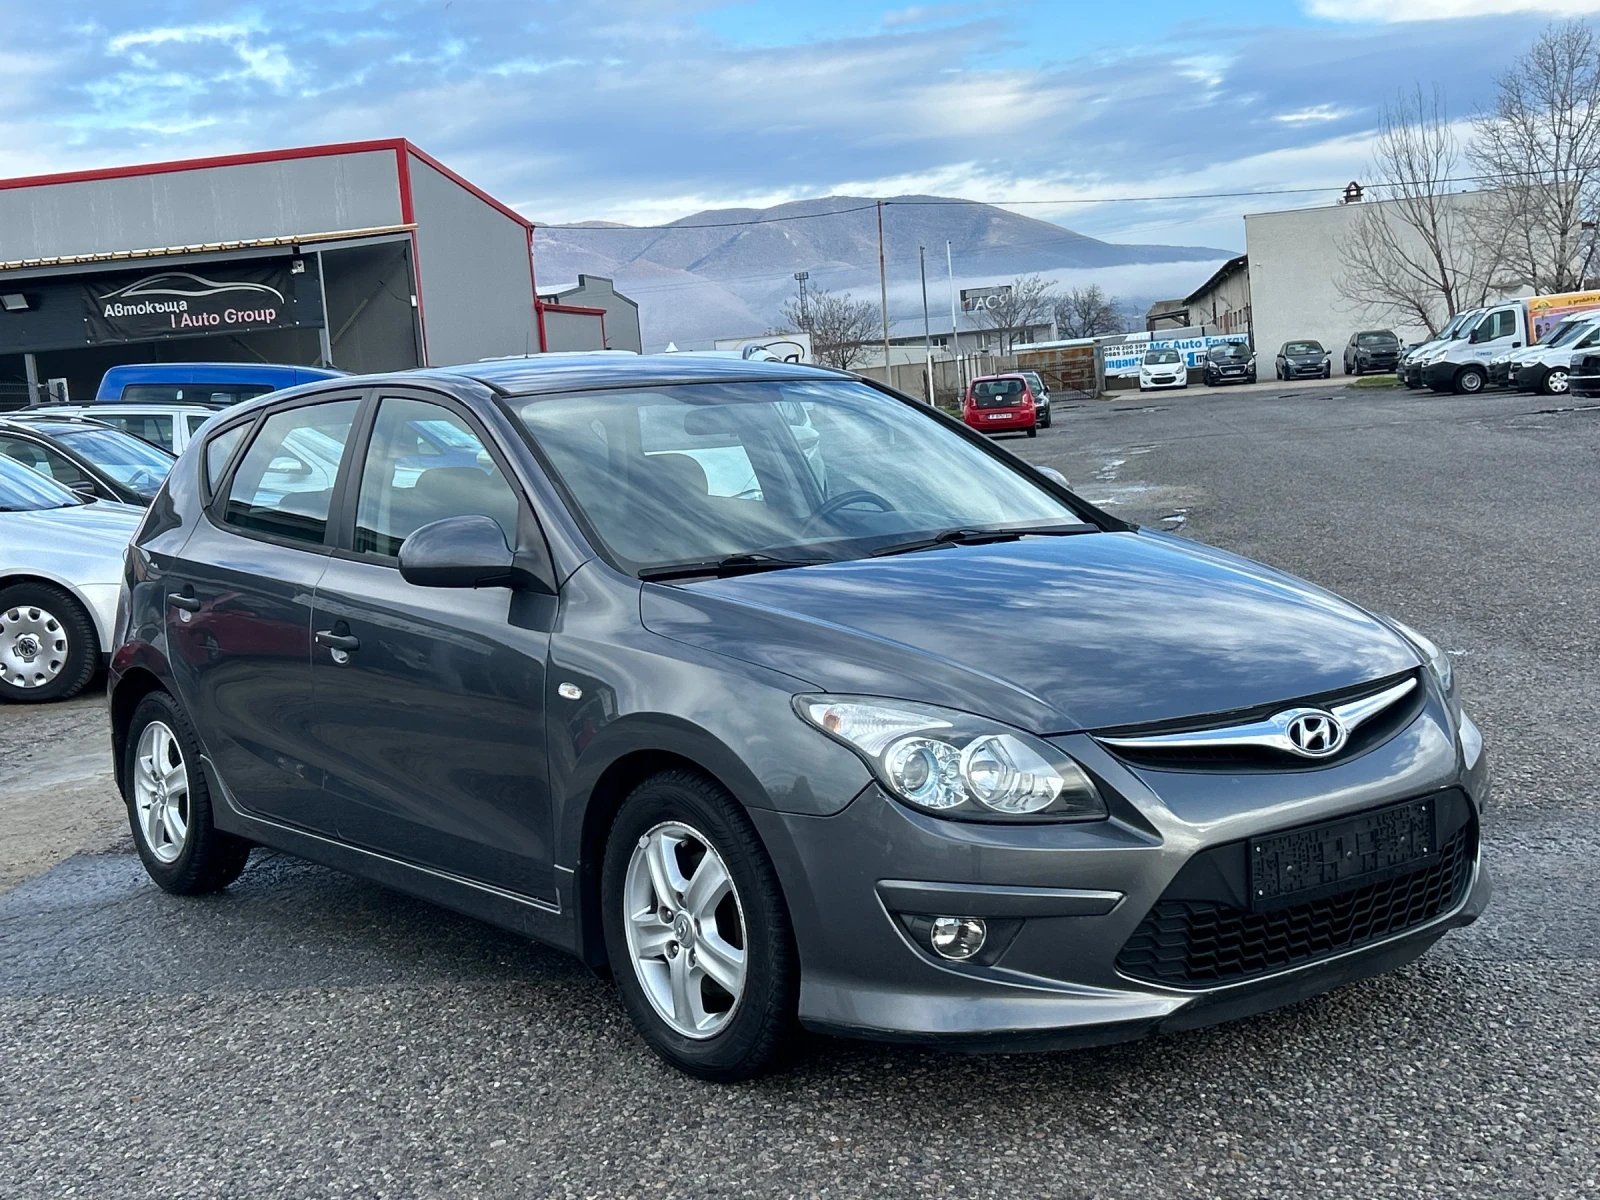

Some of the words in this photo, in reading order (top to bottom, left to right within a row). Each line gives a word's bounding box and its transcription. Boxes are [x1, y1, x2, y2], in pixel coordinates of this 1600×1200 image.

[104, 300, 188, 318] Автокъща
[180, 312, 220, 328] Auto
[224, 308, 276, 324] Group
[1173, 339, 1203, 350] Auto
